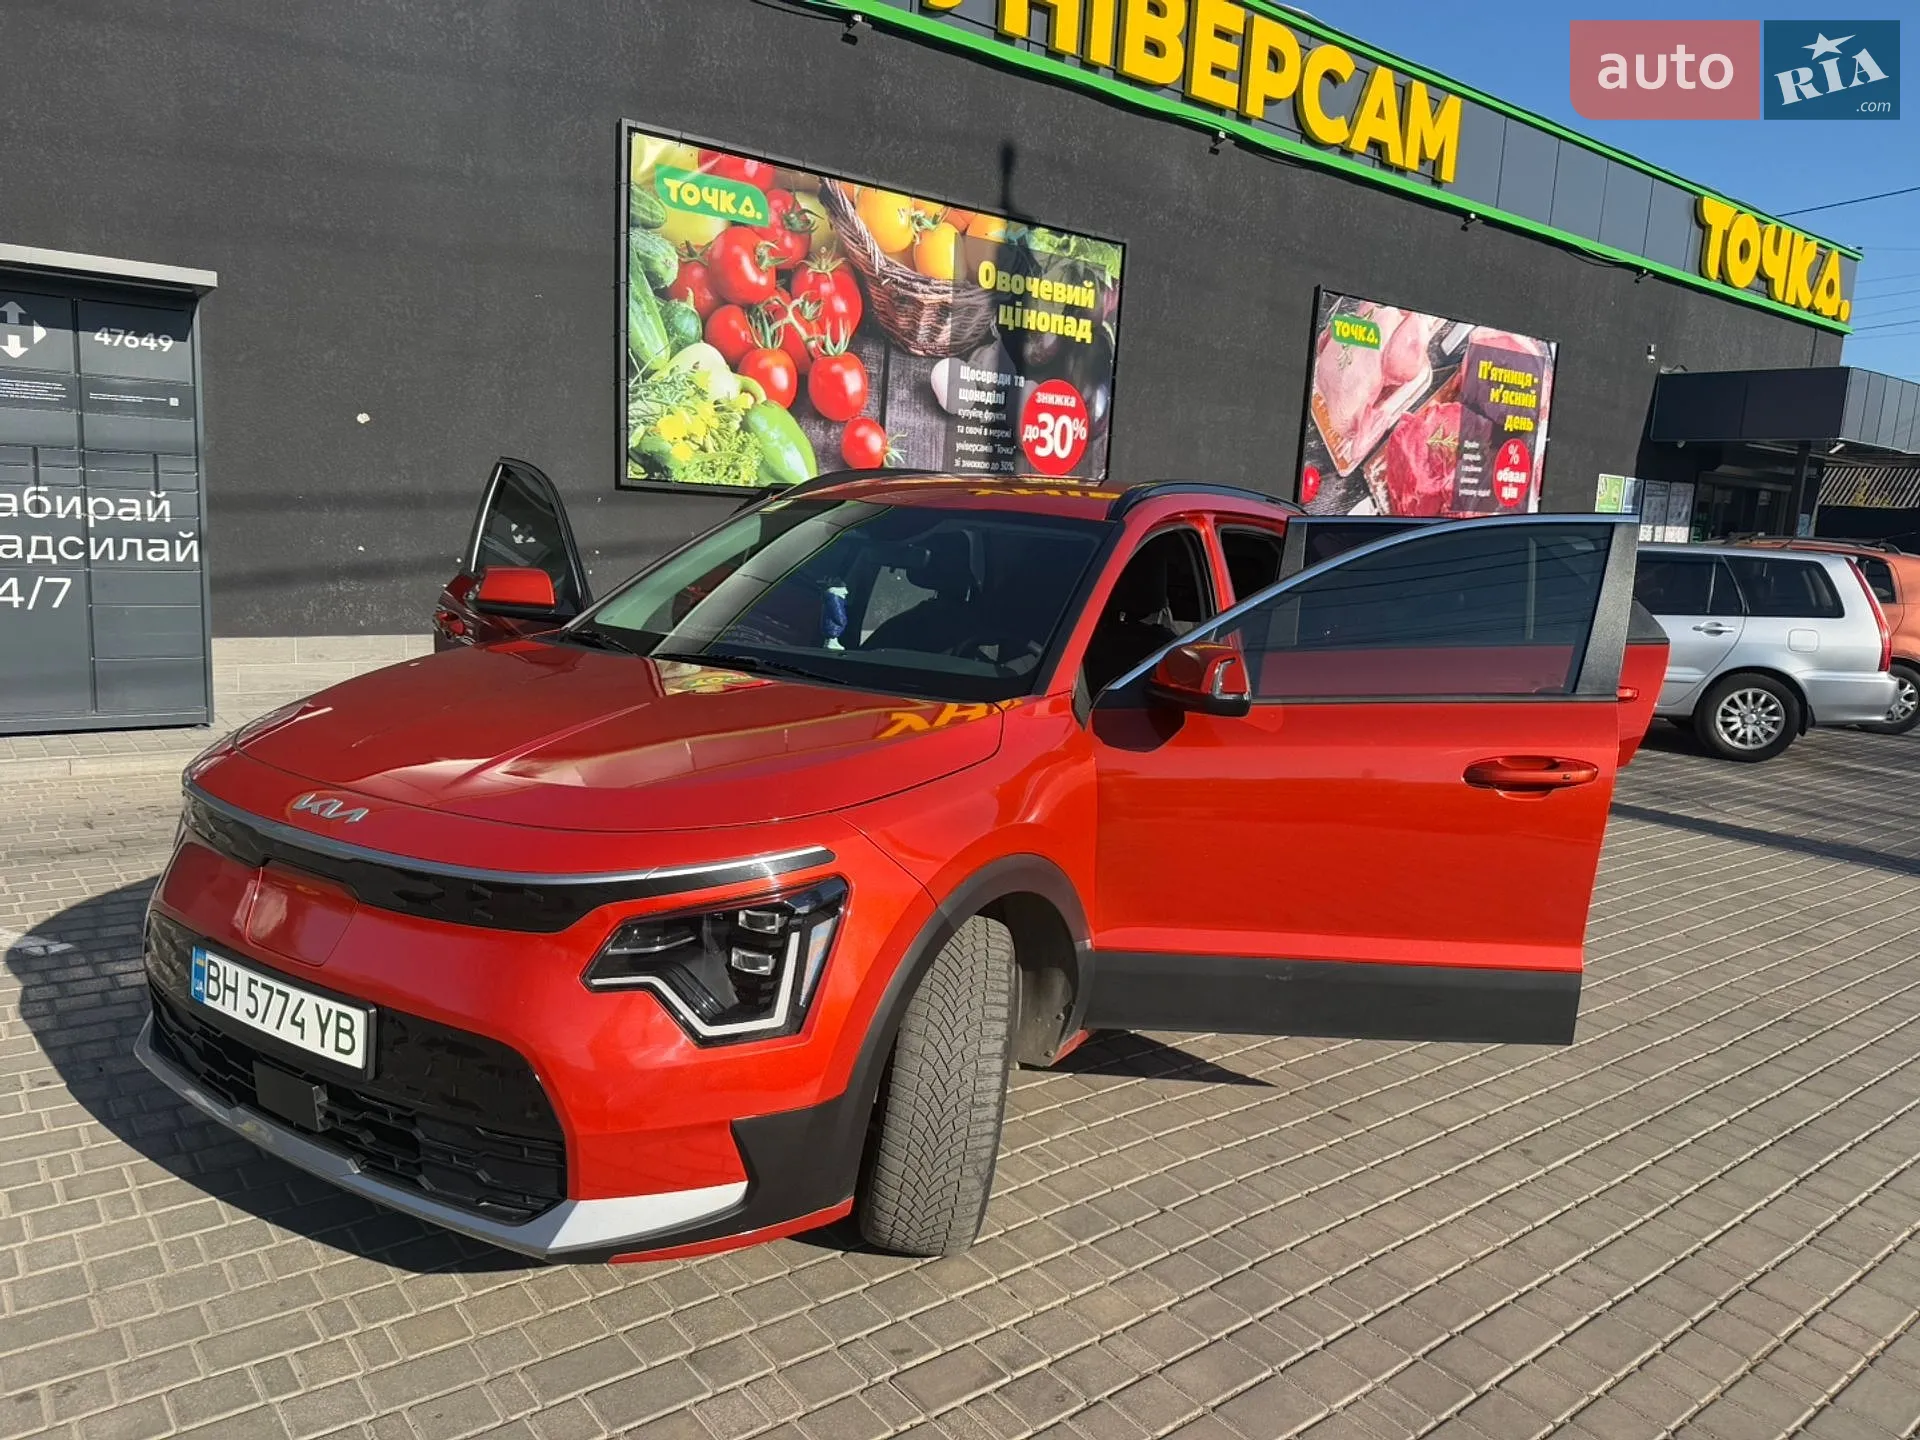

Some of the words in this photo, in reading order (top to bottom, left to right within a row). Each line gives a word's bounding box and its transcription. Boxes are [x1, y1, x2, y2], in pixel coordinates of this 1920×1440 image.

[920, 0, 1462, 184] ІВЕРСАМ
[977, 260, 1096, 309] Овочевий
[93, 327, 174, 352] 47649
[998, 303, 1093, 344] цінопад
[960, 365, 1011, 386] Щосереди
[1014, 375, 1025, 388] та
[1035, 391, 1077, 408] знижка
[1022, 423, 1039, 442] до
[1504, 414, 1534, 432] день
[0, 486, 171, 527] абирай
[0, 531, 200, 565] адсилай
[0, 575, 72, 611] 4/7
[205, 958, 240, 1012] BH
[245, 980, 306, 1041] 5774
[314, 1003, 357, 1056] YB
